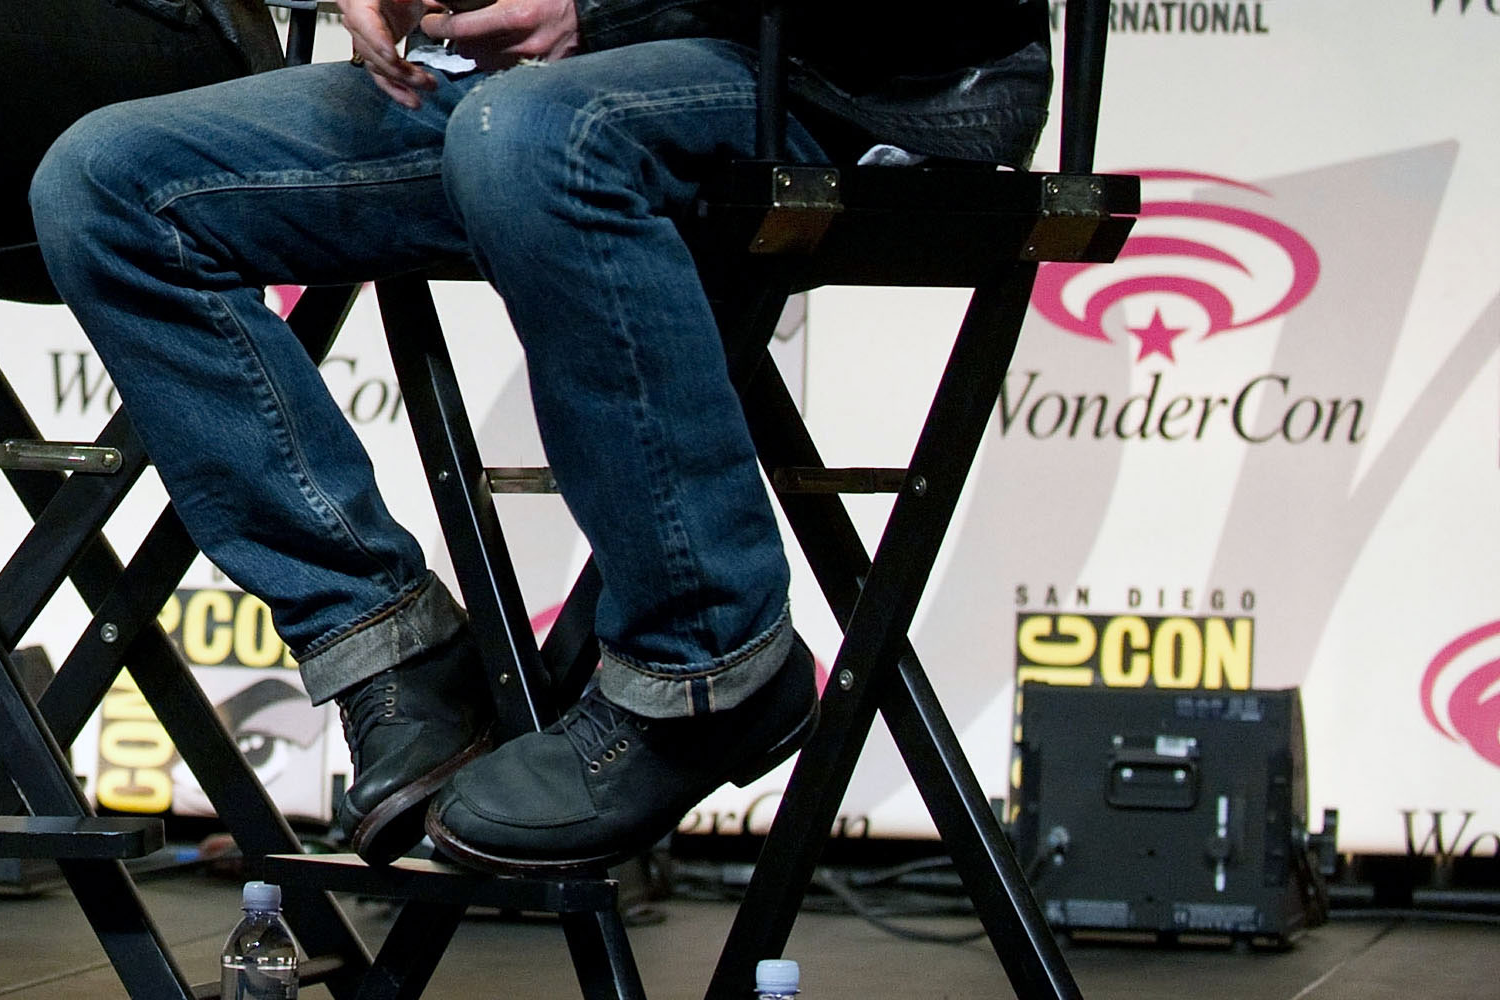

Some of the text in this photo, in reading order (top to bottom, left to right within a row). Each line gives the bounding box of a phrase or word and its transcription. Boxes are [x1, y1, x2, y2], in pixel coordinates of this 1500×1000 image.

[1015, 584, 1256, 611] SAN DIEGO
[1100, 615, 1253, 691] CON
